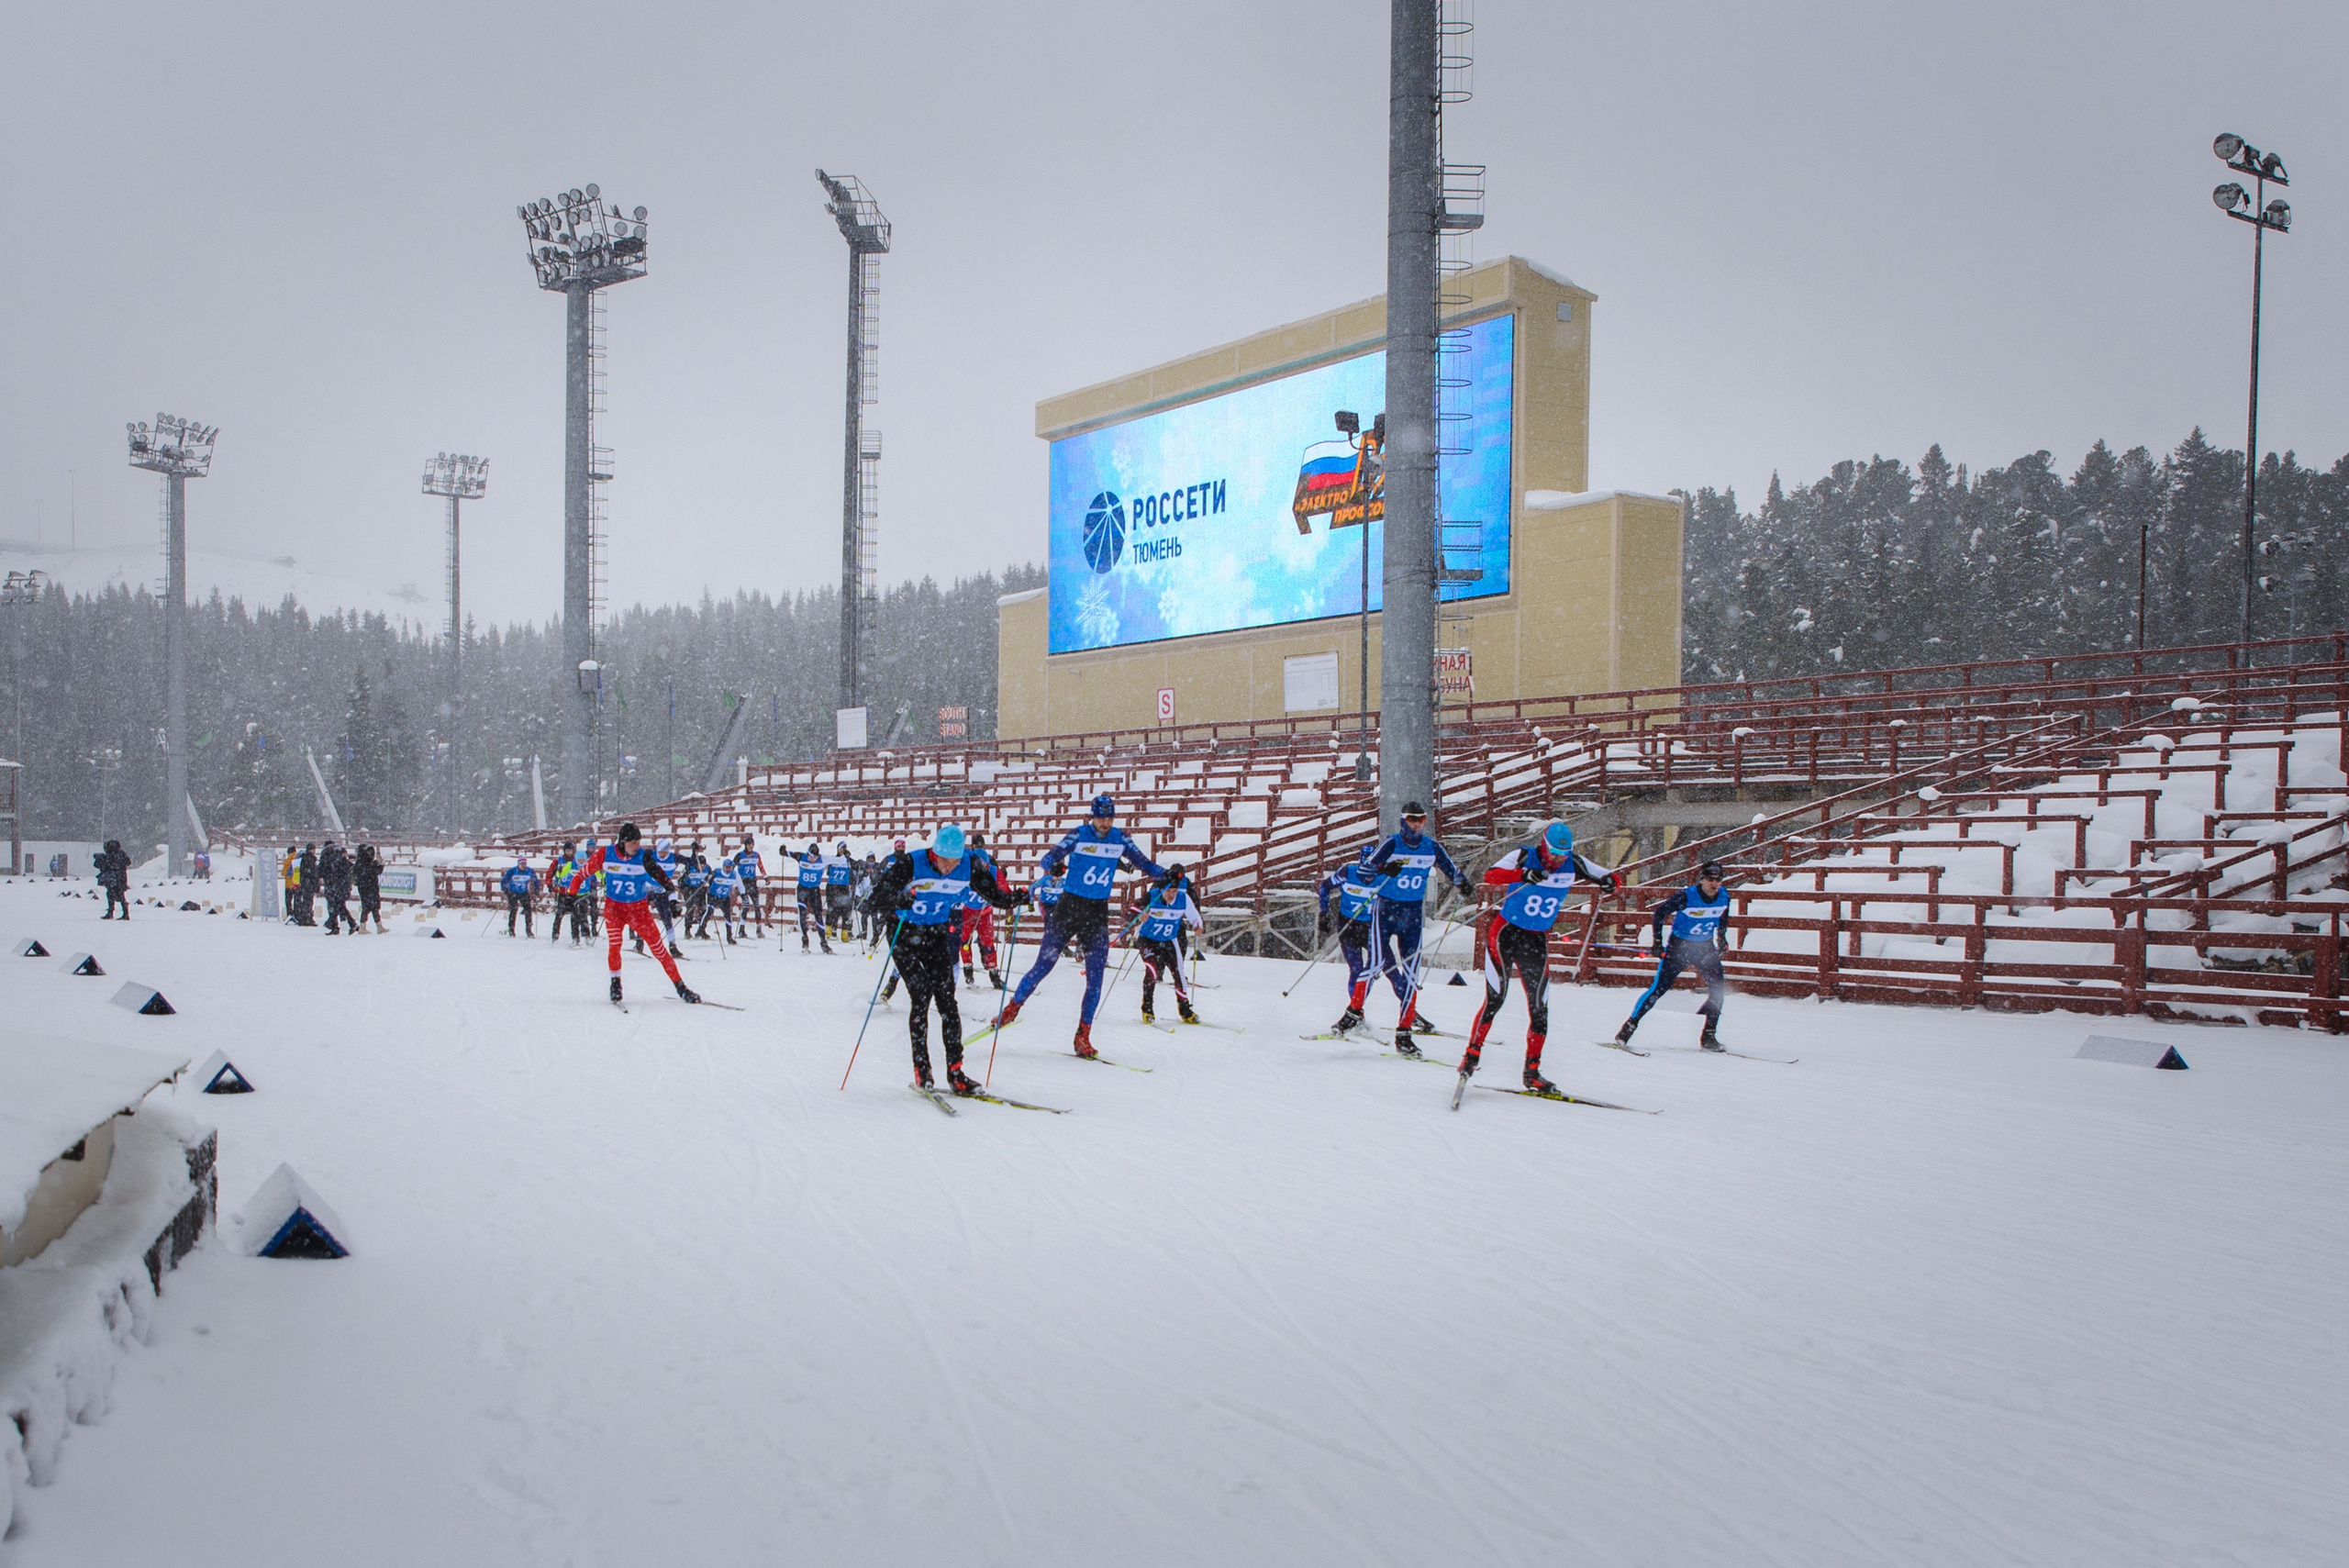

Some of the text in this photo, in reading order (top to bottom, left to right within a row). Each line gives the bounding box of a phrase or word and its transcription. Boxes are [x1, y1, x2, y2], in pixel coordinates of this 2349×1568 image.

[1132, 478, 1226, 531] РОССЕТИ
[1333, 500, 1385, 524] ПРОФСО
[1132, 537, 1182, 565] ТЮМЕНЬ
[1162, 693, 1171, 715] S
[939, 707, 964, 721] SOUTH
[940, 723, 963, 737] STAND
[802, 873, 818, 883] 85
[833, 870, 846, 880] 77
[1083, 865, 1111, 887] 64
[1397, 874, 1423, 890] 60
[612, 879, 636, 895] 73
[716, 886, 729, 895] 62
[1523, 895, 1559, 918] 83
[1152, 923, 1174, 937] 78
